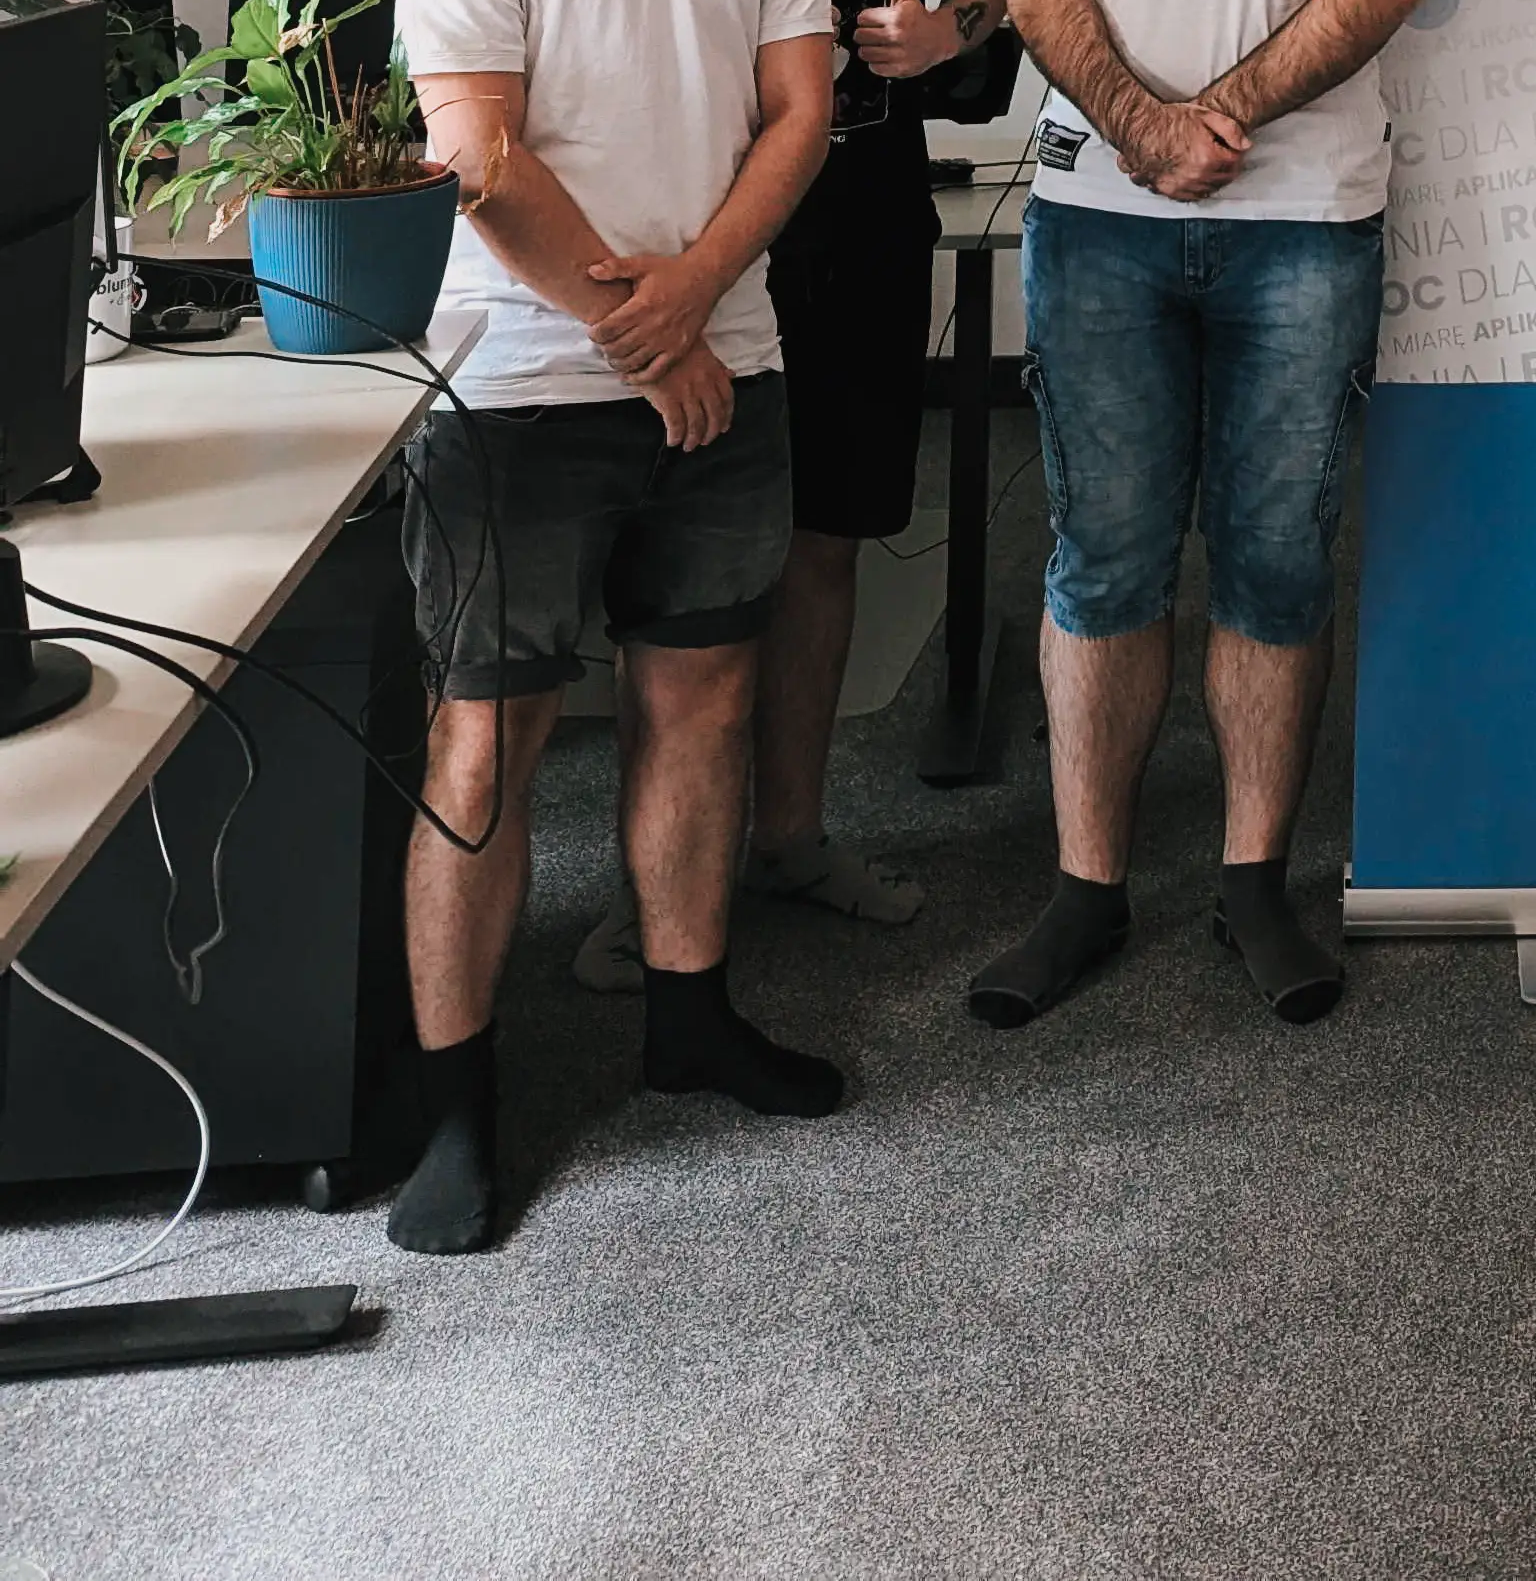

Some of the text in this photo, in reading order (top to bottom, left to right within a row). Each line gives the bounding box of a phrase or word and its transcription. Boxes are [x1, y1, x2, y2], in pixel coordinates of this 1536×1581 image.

[1439, 120, 1519, 162] DLA
[1384, 217, 1465, 262] NIA
[1393, 325, 1466, 357] MIARĘ
